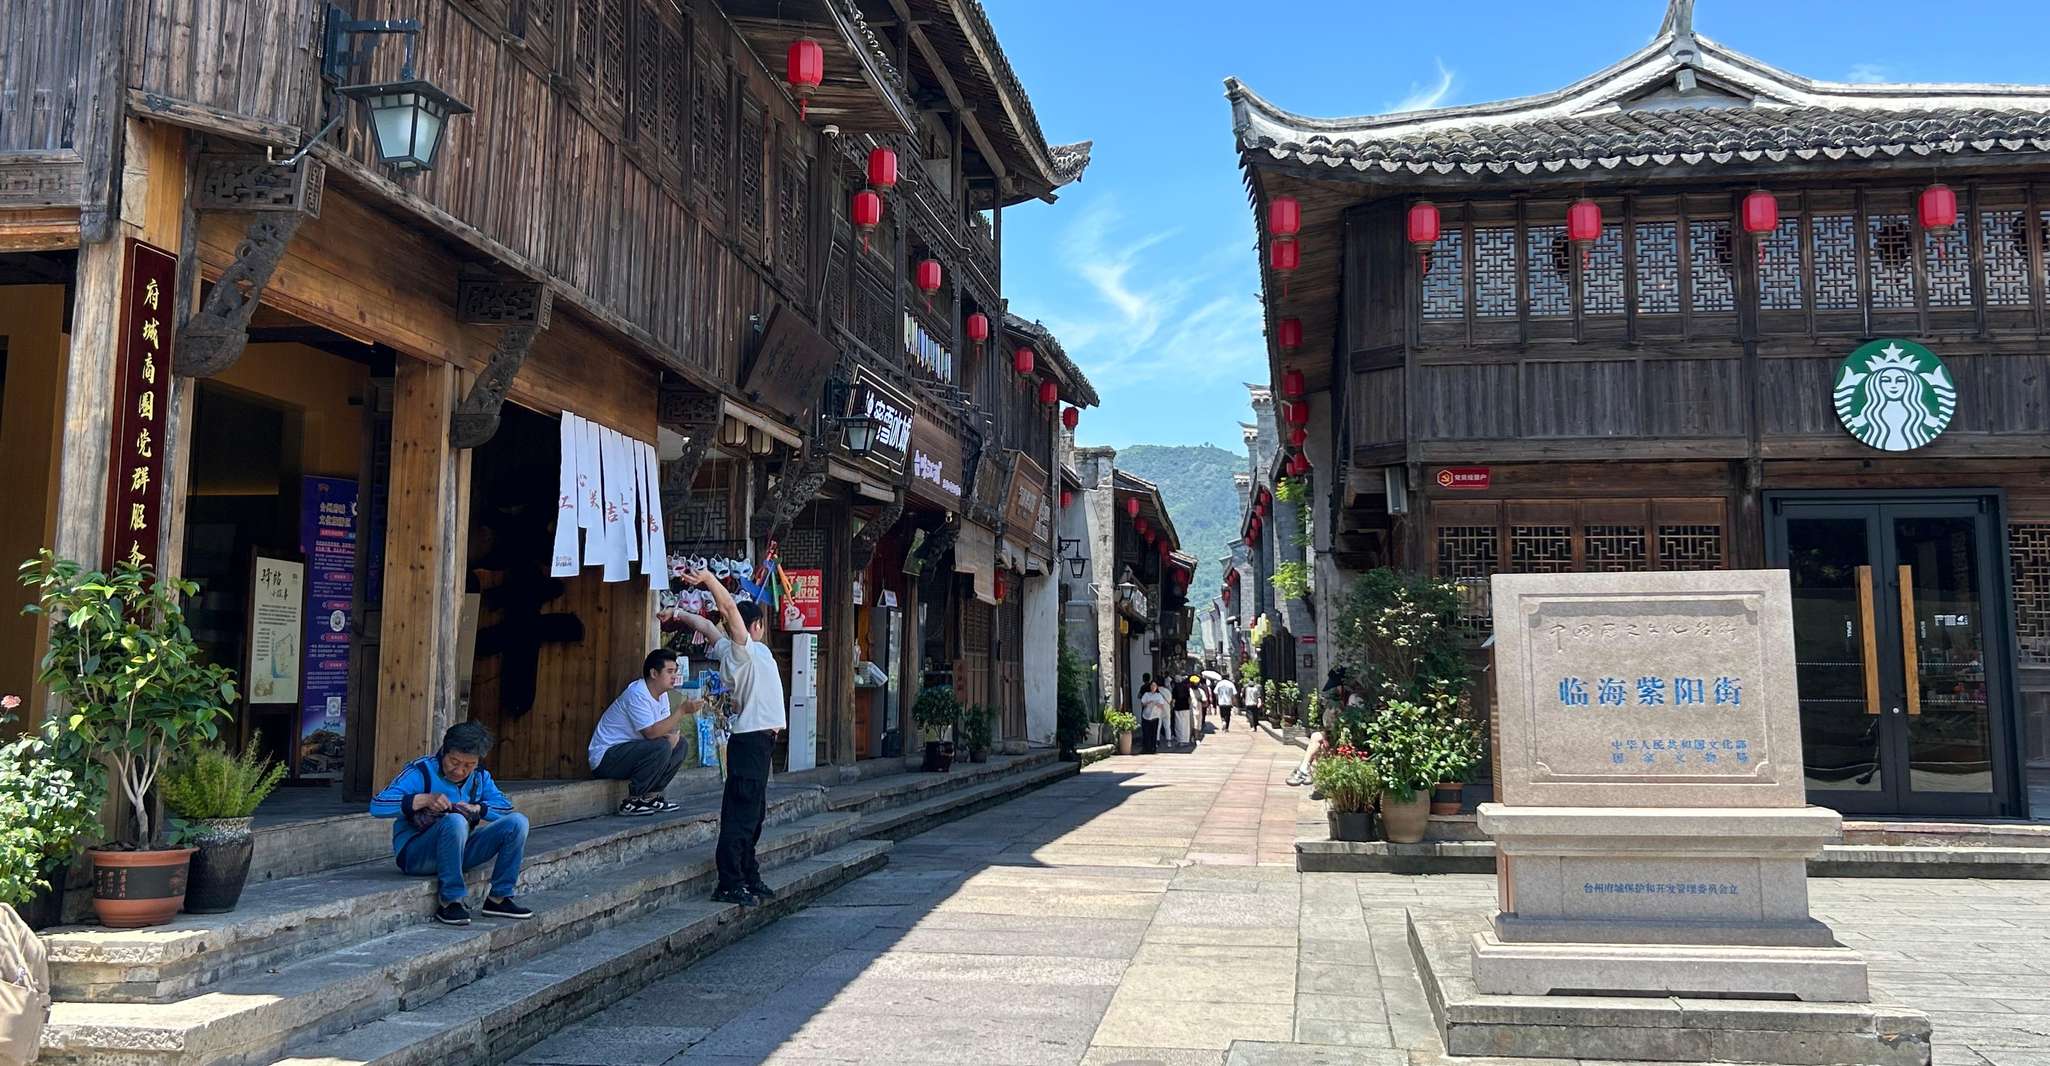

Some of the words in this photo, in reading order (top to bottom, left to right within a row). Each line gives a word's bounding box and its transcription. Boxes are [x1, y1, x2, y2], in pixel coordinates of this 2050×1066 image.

[124, 278, 160, 624] 府城商圈党群服务
[1558, 676, 1743, 706] 临海紫阳街
